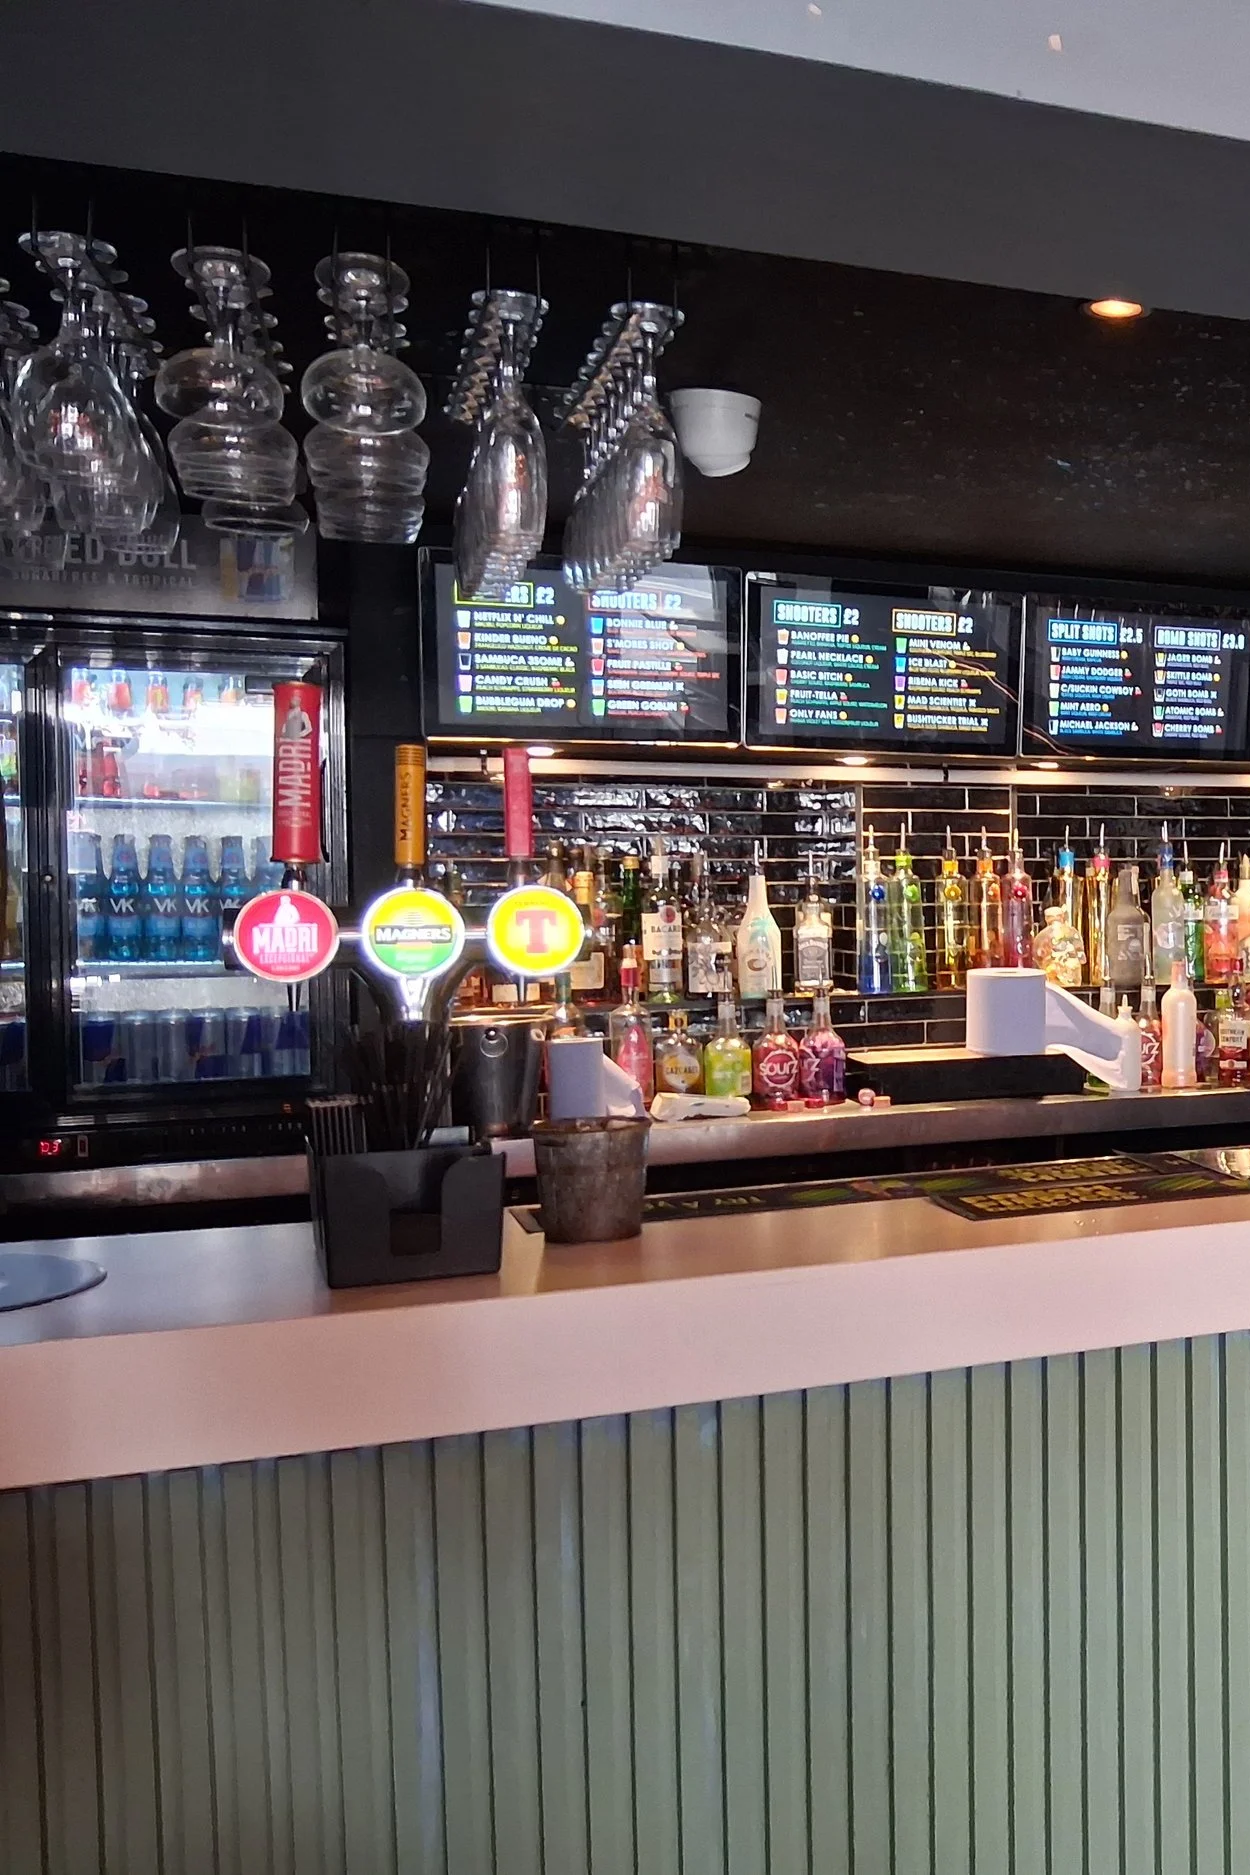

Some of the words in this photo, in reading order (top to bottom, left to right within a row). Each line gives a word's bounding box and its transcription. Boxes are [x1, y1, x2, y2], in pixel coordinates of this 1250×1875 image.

[536, 586, 554, 604] £2
[592, 592, 657, 610] SHOOTERS
[664, 594, 681, 609] £2
[474, 612, 511, 622] NETFLIX
[526, 615, 554, 624] CHILL
[777, 604, 837, 624] SHOOTERS
[843, 608, 859, 625] £2
[607, 618, 643, 628] BONNIE
[645, 620, 666, 629] BLUE
[896, 613, 952, 632] SHOOTERS
[958, 617, 973, 633] £2
[791, 631, 835, 642] BANOFFEE
[837, 633, 849, 642] PIE
[1052, 623, 1080, 639] SPLIT
[1082, 625, 1114, 641] SHOTS
[1119, 628, 1143, 643] £2.5
[1158, 629, 1185, 645] BOMB
[1188, 631, 1218, 647] SHOTS
[474, 633, 510, 643] KINDER
[512, 634, 547, 645] BUENO
[607, 639, 647, 649] S'MORES
[649, 640, 674, 650] SHOT
[909, 639, 928, 648] MINI
[930, 640, 960, 649] VENOM
[791, 651, 817, 661] PEARL
[819, 652, 863, 663] NECKLACE
[1062, 647, 1082, 656] BABY
[1083, 649, 1119, 659] GUINNESS
[1167, 653, 1190, 662] JAGER
[1192, 655, 1213, 664] BOMB
[475, 654, 526, 664] SAMBUCA
[607, 659, 631, 669] FRUIT
[633, 660, 671, 670] PASTILLE
[909, 658, 922, 667] ICE
[924, 659, 947, 668] BLAST
[790, 670, 816, 679] BASIC
[818, 672, 842, 681] BITCH
[1061, 666, 1089, 675] JAMMY
[1091, 667, 1123, 677] DODGER
[1167, 671, 1190, 680] SKITTLE
[1192, 672, 1212, 681] BOMB
[475, 675, 513, 685] CANDY
[515, 677, 548, 686] CRUSH
[908, 677, 937, 686] RIBENA
[939, 678, 958, 687] KICK
[790, 690, 838, 700] FRUIT-TELLA
[1099, 685, 1133, 695] COWBOY
[1166, 689, 1186, 697] GOTH
[1188, 690, 1208, 698] BOMB
[476, 696, 535, 706] BUBBLEGUM
[537, 698, 564, 708] DROP
[608, 700, 639, 710] GREEN
[641, 702, 677, 711] GOBLIN
[908, 695, 928, 704] MAD
[929, 697, 966, 706] SCIENTIST
[1060, 702, 1078, 711] MINT
[1080, 703, 1101, 711] AERO
[1165, 706, 1193, 715] ATOMIC
[1195, 708, 1216, 716] BOMB
[789, 709, 813, 718] ONLY
[815, 710, 837, 719] FANS
[907, 714, 957, 725] BUSHTUCKER
[958, 716, 978, 726] TRIAL
[1060, 720, 1093, 729] MICHAEL
[1094, 721, 1130, 730] JACKSON
[1165, 724, 1191, 732] CHERRY
[1193, 725, 1214, 734] BOMB
[279, 738, 311, 807] MADRI
[399, 772, 412, 841] MAGNERS
[110, 898, 134, 913] VK
[154, 898, 177, 912] VK
[185, 898, 209, 913] VK
[376, 927, 451, 942] MAGNERS
[516, 911, 558, 953] T
[252, 923, 318, 955] MADRI
[759, 1060, 798, 1076] sourz
